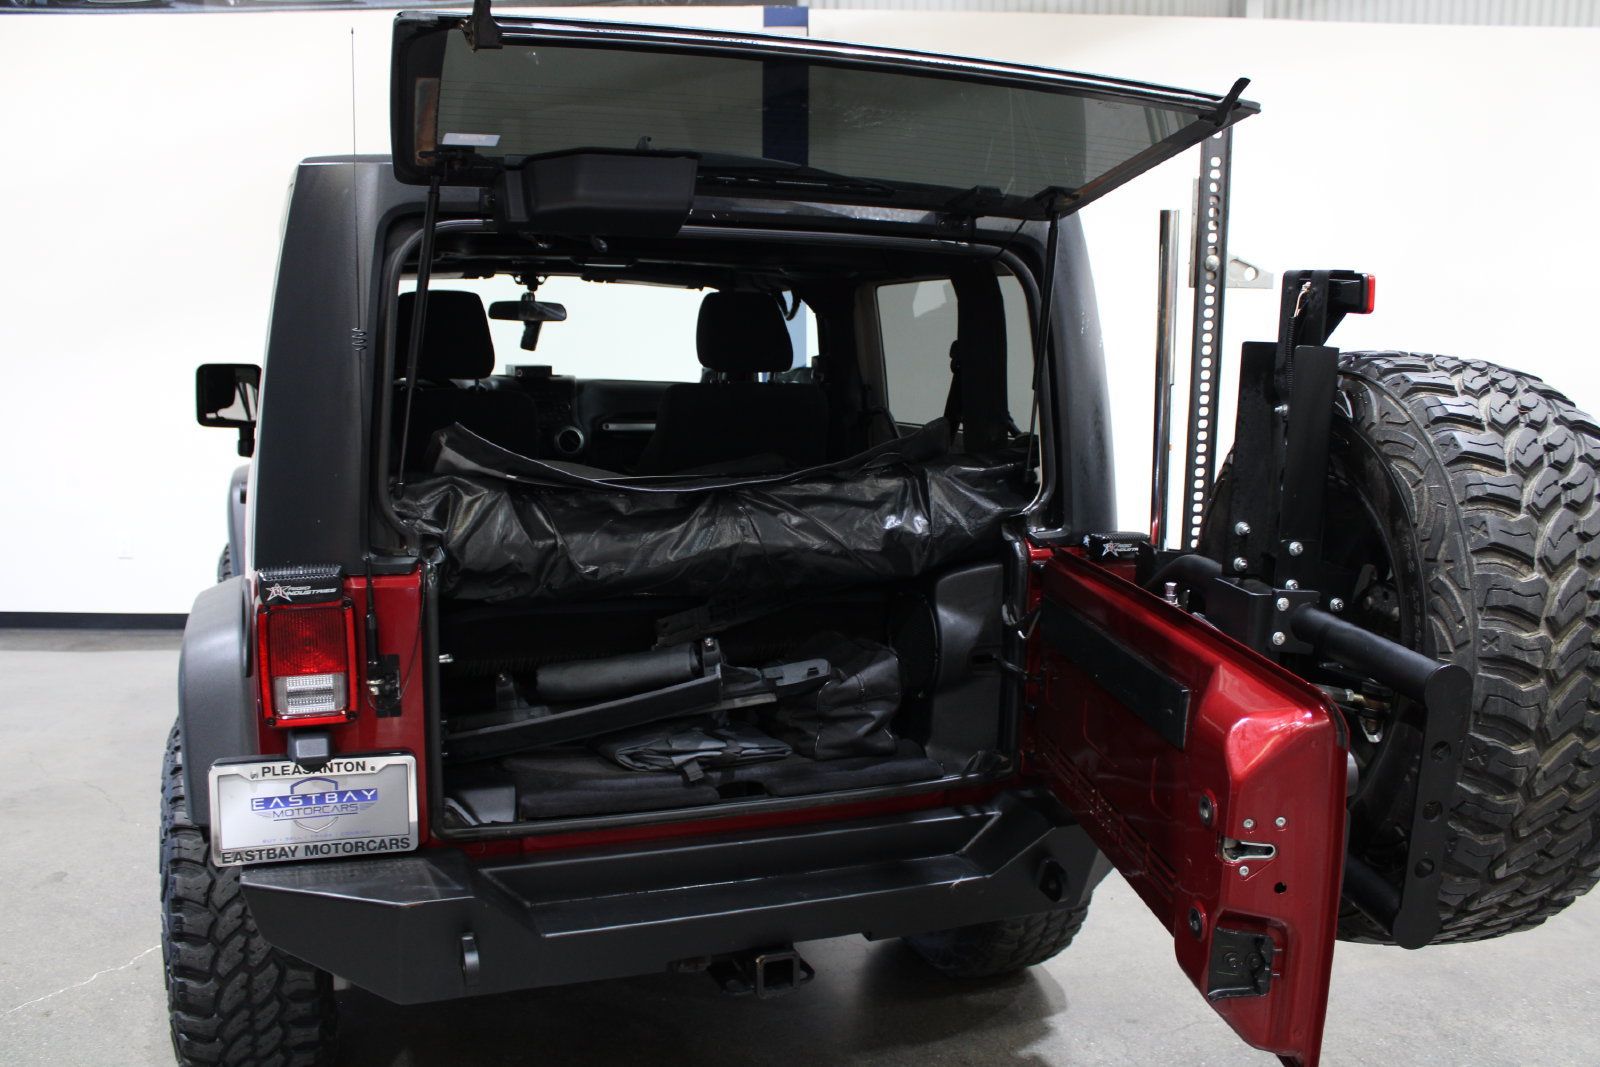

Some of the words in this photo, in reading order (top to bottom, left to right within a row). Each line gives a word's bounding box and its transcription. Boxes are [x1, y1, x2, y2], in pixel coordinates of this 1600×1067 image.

[252, 789, 376, 810] EASTBAY
[272, 803, 359, 819] MOTORCARS
[221, 846, 299, 864] EASTBAY
[304, 837, 411, 857] MOTORCARS
